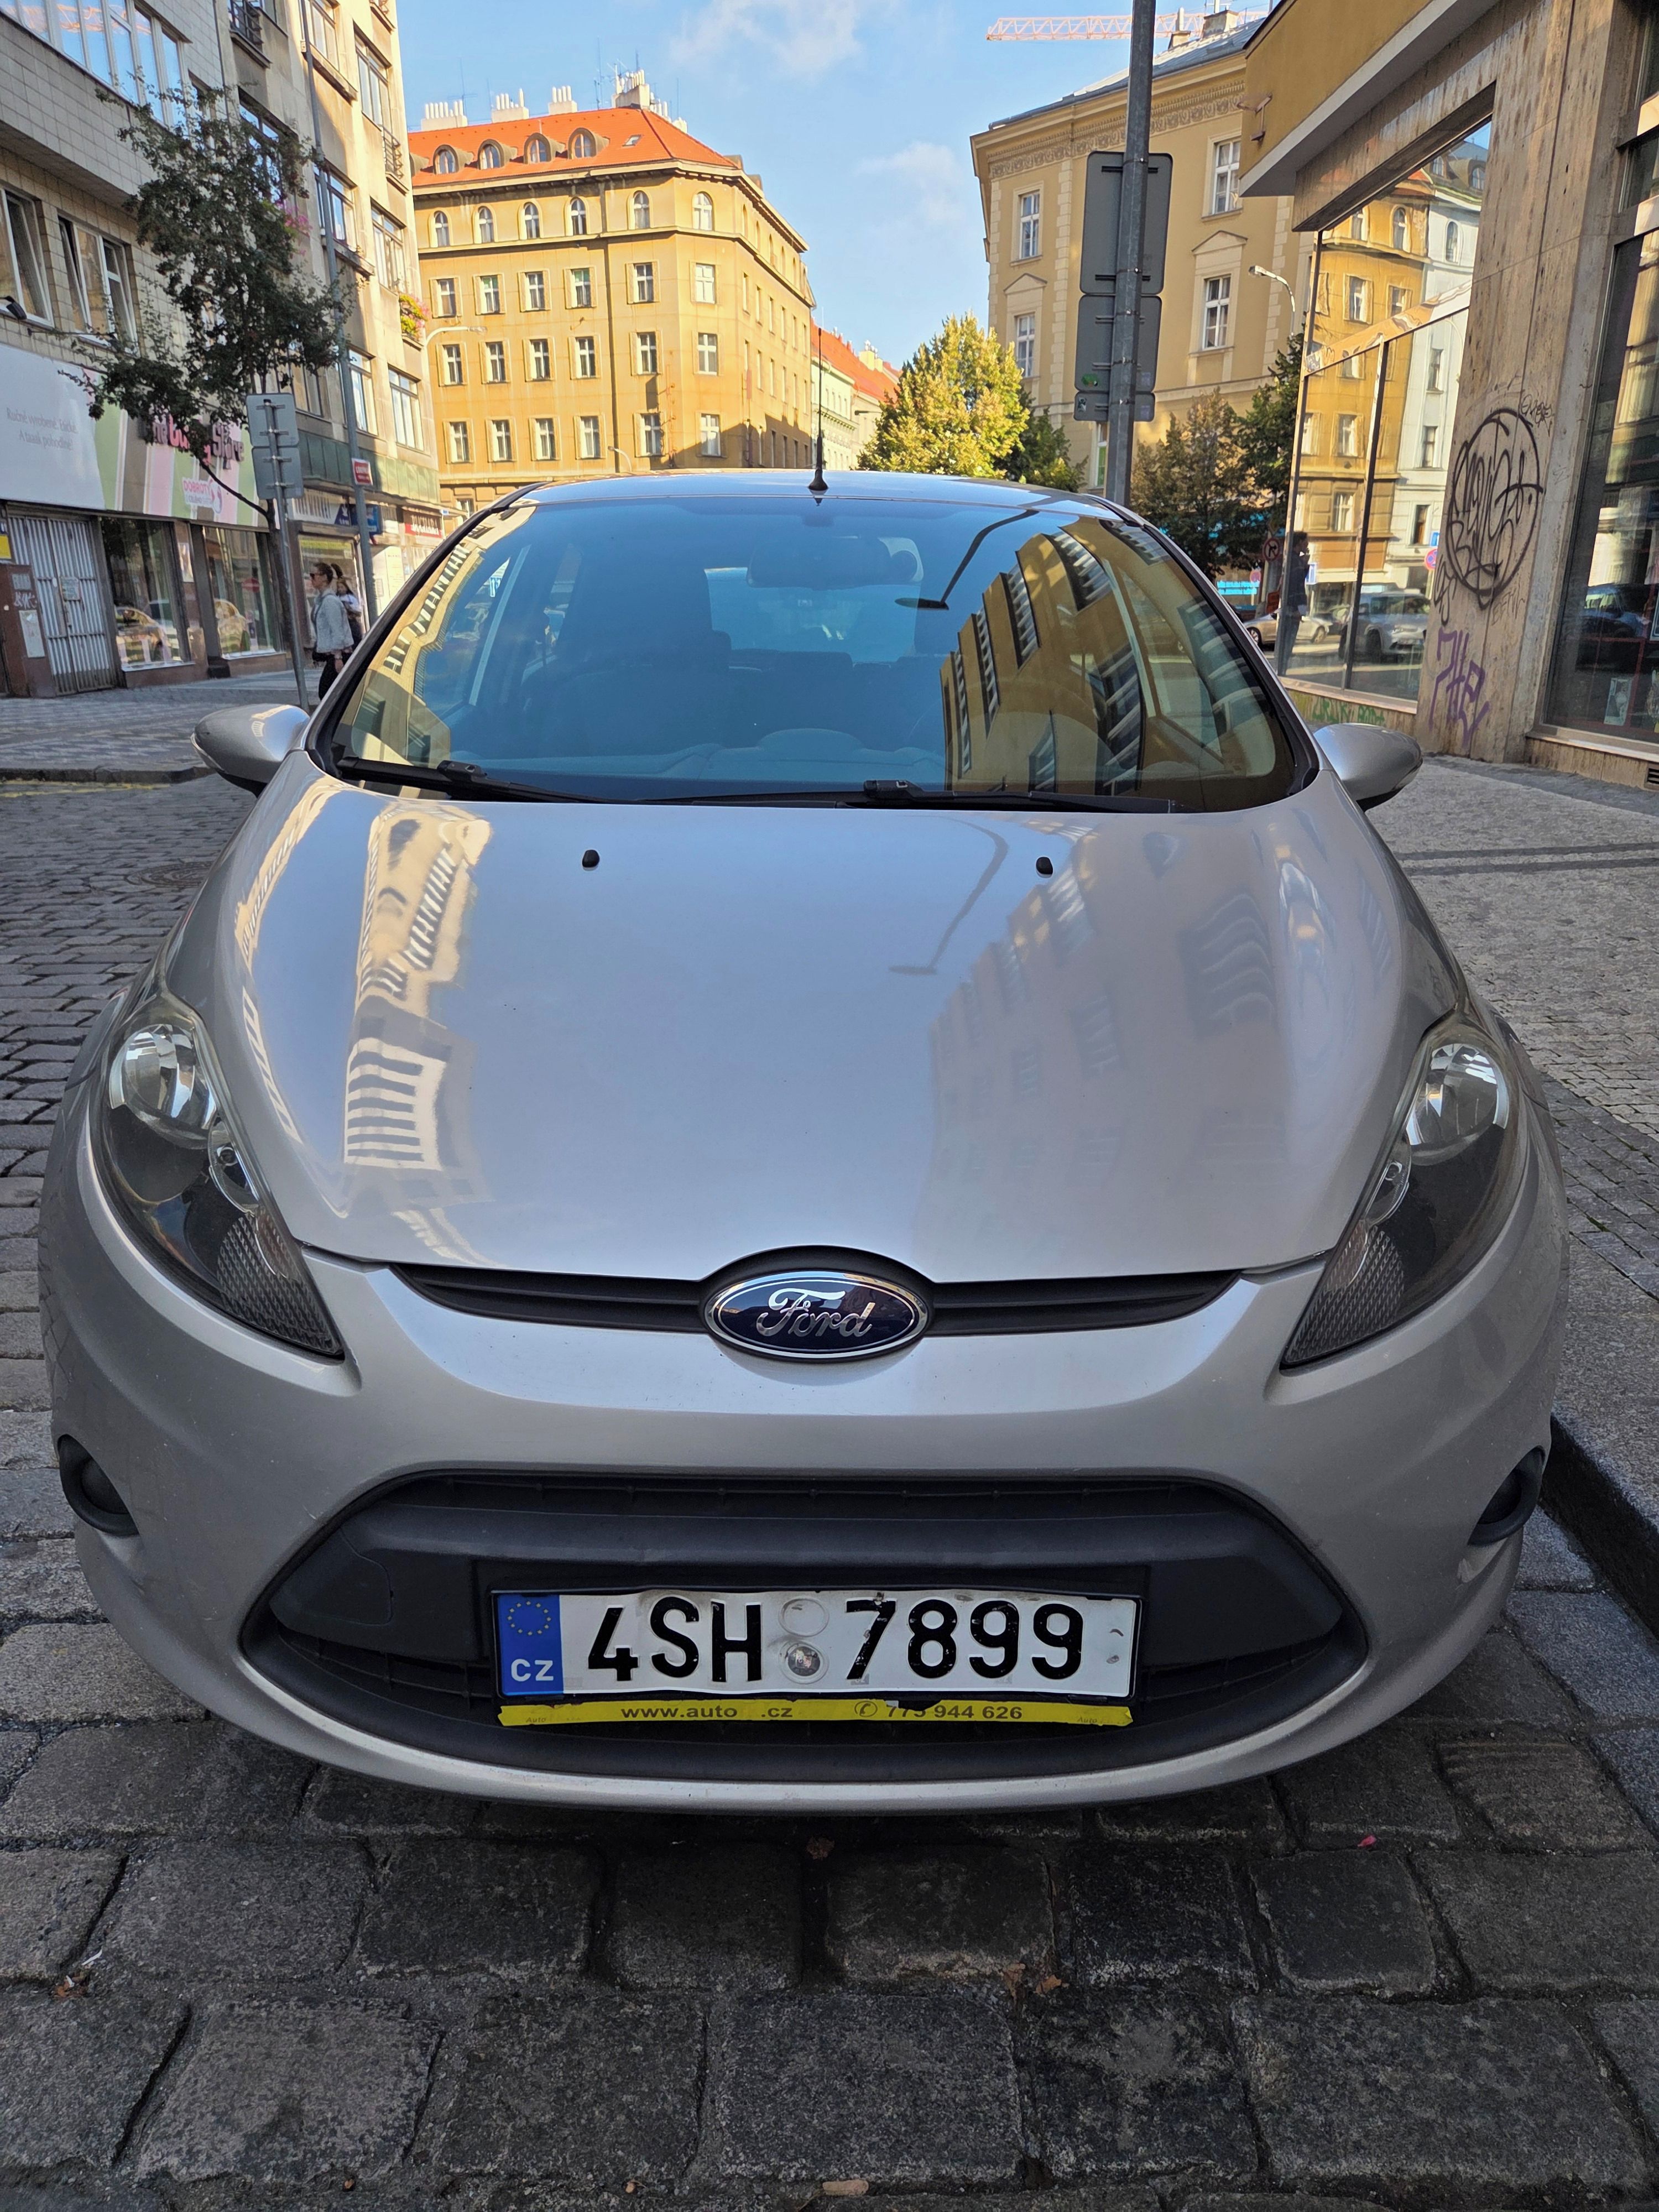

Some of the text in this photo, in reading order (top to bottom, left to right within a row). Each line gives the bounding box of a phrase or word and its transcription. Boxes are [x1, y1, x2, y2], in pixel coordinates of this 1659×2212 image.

[183, 479, 211, 494] DOBROTY
[756, 1287, 876, 1337] Ford
[588, 1596, 1083, 1682] 4SH 7899
[510, 1658, 554, 1682] CZ
[934, 1705, 974, 1718] 944
[983, 1706, 1023, 1719] 626
